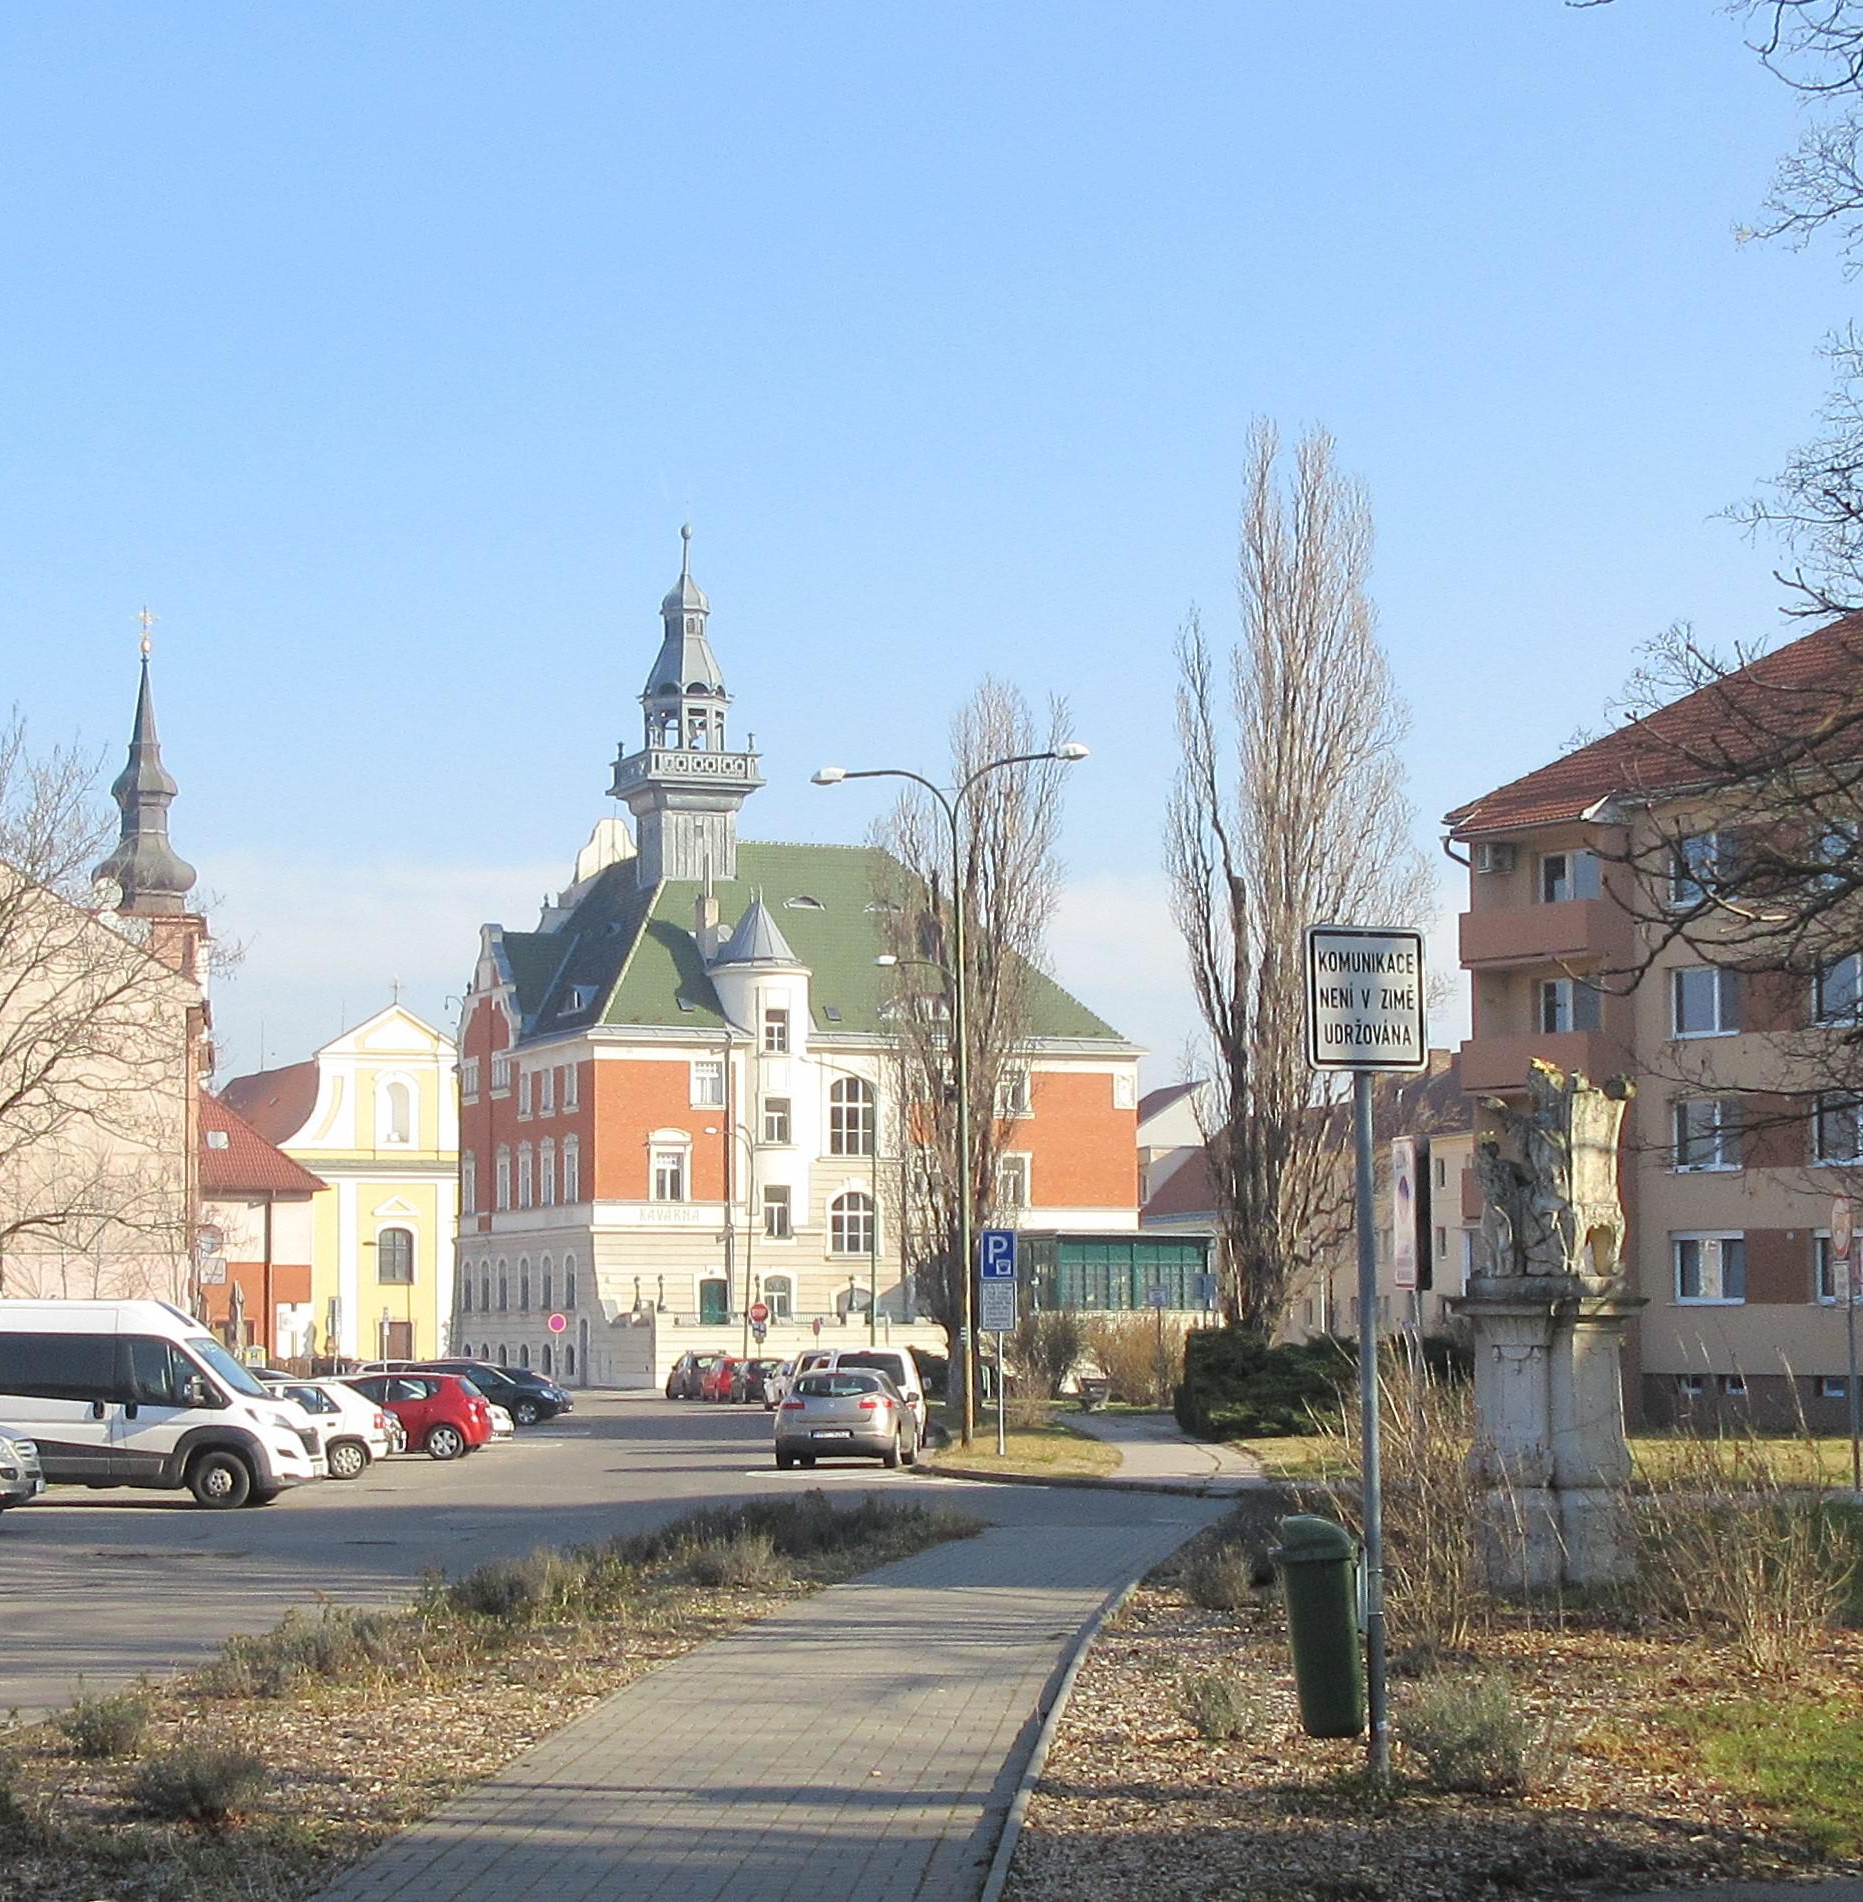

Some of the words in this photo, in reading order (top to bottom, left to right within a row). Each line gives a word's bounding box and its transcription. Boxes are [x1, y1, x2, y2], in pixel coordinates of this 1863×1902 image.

[1318, 951, 1414, 974] KOMUNIKACE
[1320, 983, 1354, 1009] NENÍ
[1361, 989, 1371, 1009] V
[1381, 984, 1415, 1010] ZIMĚ
[1324, 1019, 1412, 1045] UDRŽOVÁNA
[988, 1235, 1008, 1264] P
